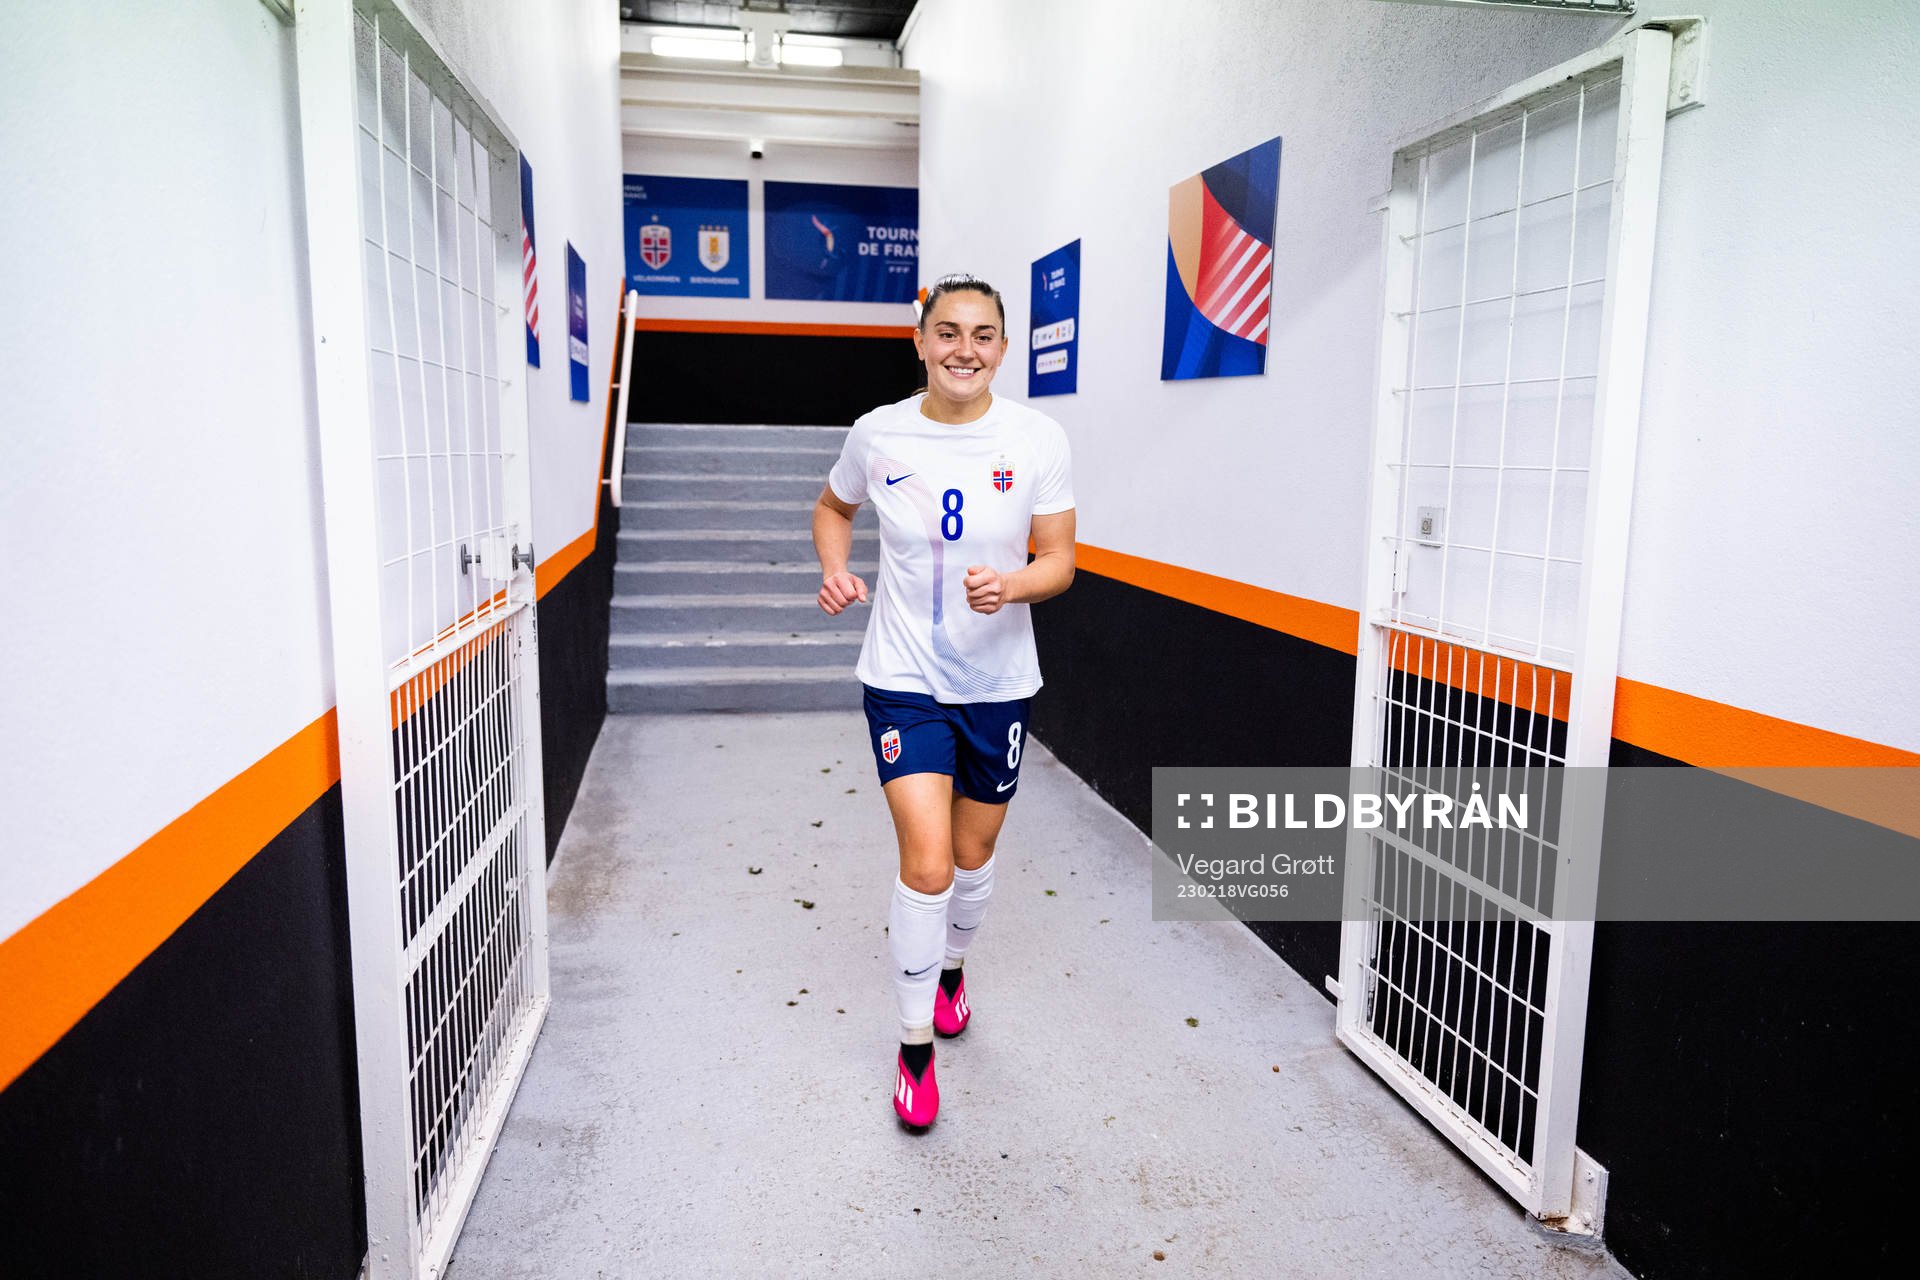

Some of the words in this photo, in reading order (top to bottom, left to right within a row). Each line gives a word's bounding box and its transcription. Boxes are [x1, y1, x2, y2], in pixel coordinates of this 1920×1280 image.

[858, 242, 879, 257] DE
[941, 488, 964, 541] 8
[1007, 721, 1022, 770] 8
